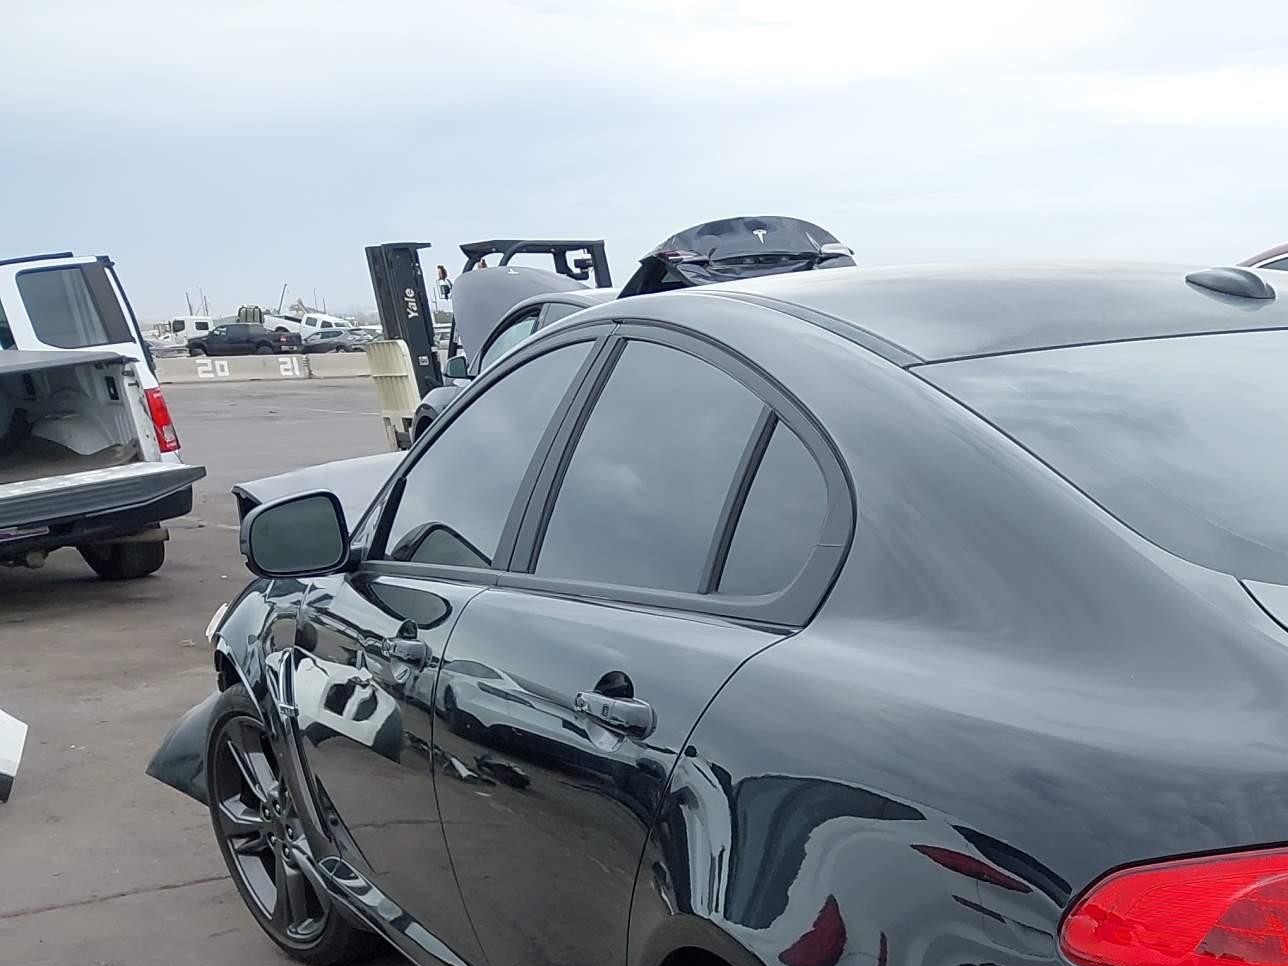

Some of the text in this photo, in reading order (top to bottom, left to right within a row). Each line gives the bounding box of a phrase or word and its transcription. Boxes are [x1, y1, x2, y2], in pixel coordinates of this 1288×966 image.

[404, 287, 419, 319] Yale
[195, 358, 230, 378] 20
[278, 356, 301, 377] 21
